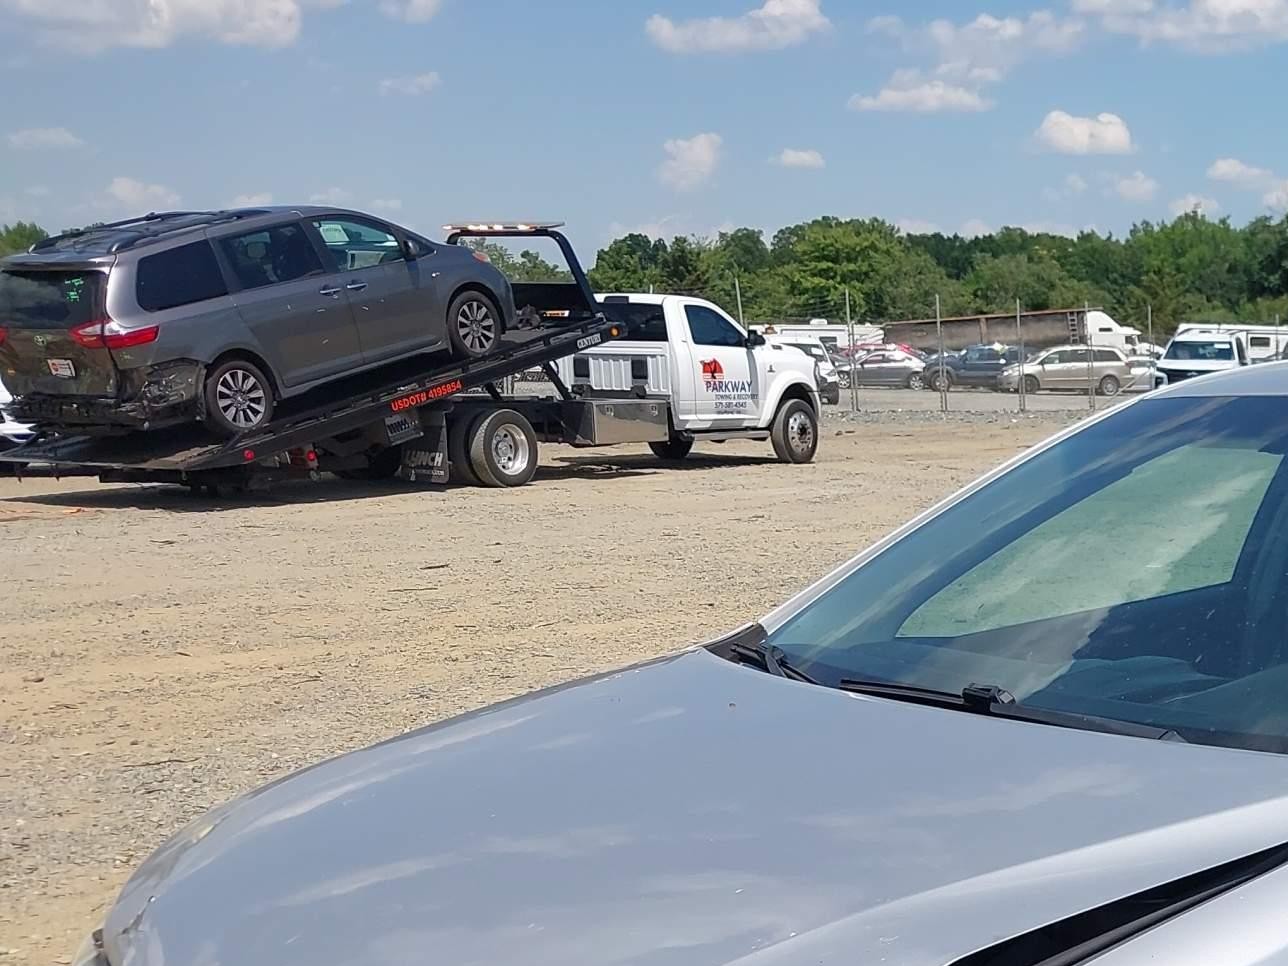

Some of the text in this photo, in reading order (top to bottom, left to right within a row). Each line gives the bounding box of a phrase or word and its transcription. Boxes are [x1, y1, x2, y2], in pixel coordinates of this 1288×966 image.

[391, 380, 462, 411] USDOT# 4195854
[705, 380, 752, 393] PARKWAY
